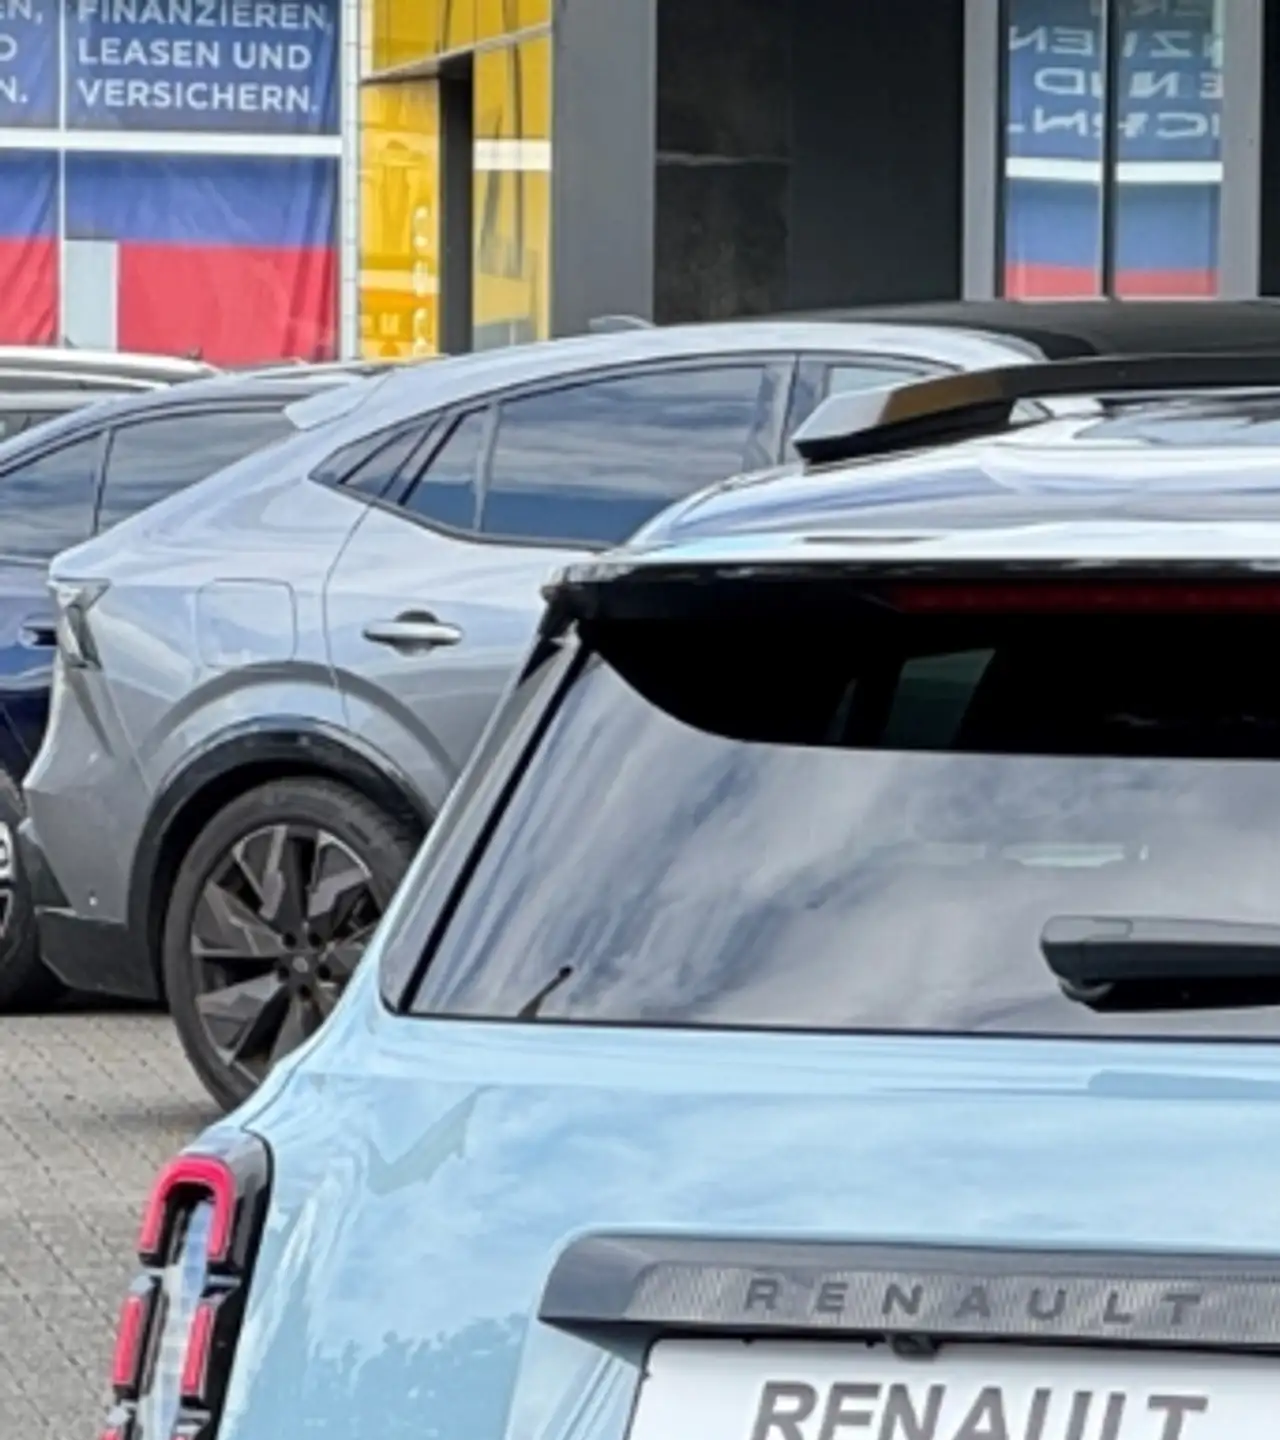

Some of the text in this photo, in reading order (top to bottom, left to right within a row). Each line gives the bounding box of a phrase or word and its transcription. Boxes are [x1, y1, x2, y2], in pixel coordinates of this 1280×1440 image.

[77, 37, 312, 70] LEASEN UND
[76, 77, 320, 114] VERSICHERN.
[743, 1278, 1204, 1324] RENAULT
